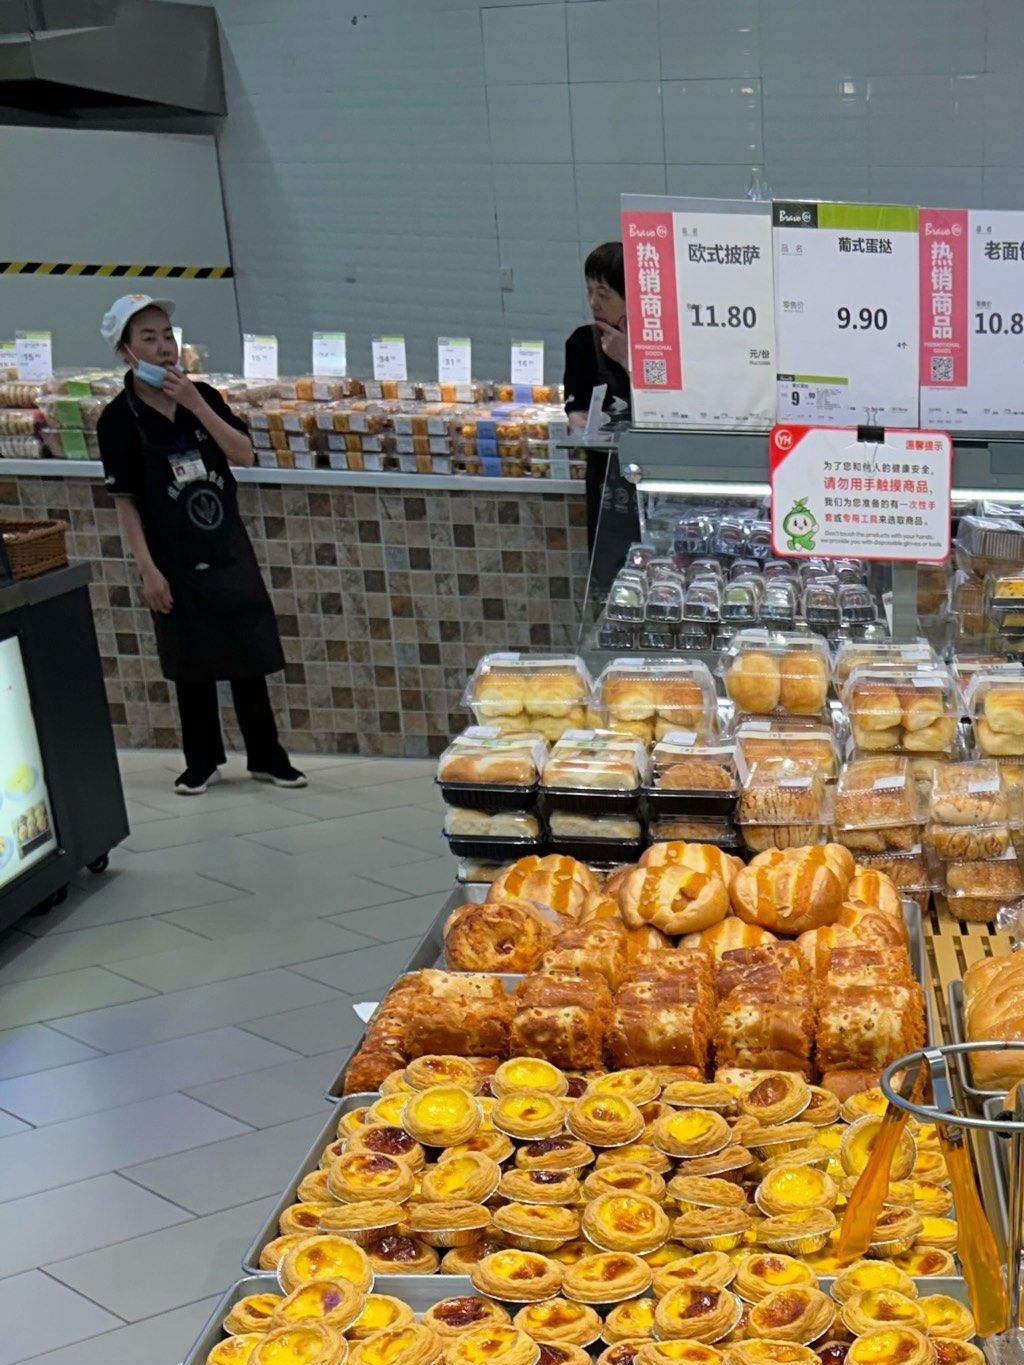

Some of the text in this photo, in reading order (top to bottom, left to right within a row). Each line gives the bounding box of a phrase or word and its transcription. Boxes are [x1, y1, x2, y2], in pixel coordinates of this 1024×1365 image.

[688, 243, 760, 265] 欧式披萨
[838, 237, 893, 254] 葡式蛋挞
[637, 242, 664, 341] 热销商品
[931, 241, 953, 339] 热销商品
[691, 304, 757, 328] 11.80
[837, 307, 888, 330] 9.90
[749, 349, 770, 359] 元/份
[777, 435, 793, 445] YH
[905, 440, 943, 451] 温馨提示
[825, 497, 936, 511] 我们为您准备的有一次性手
